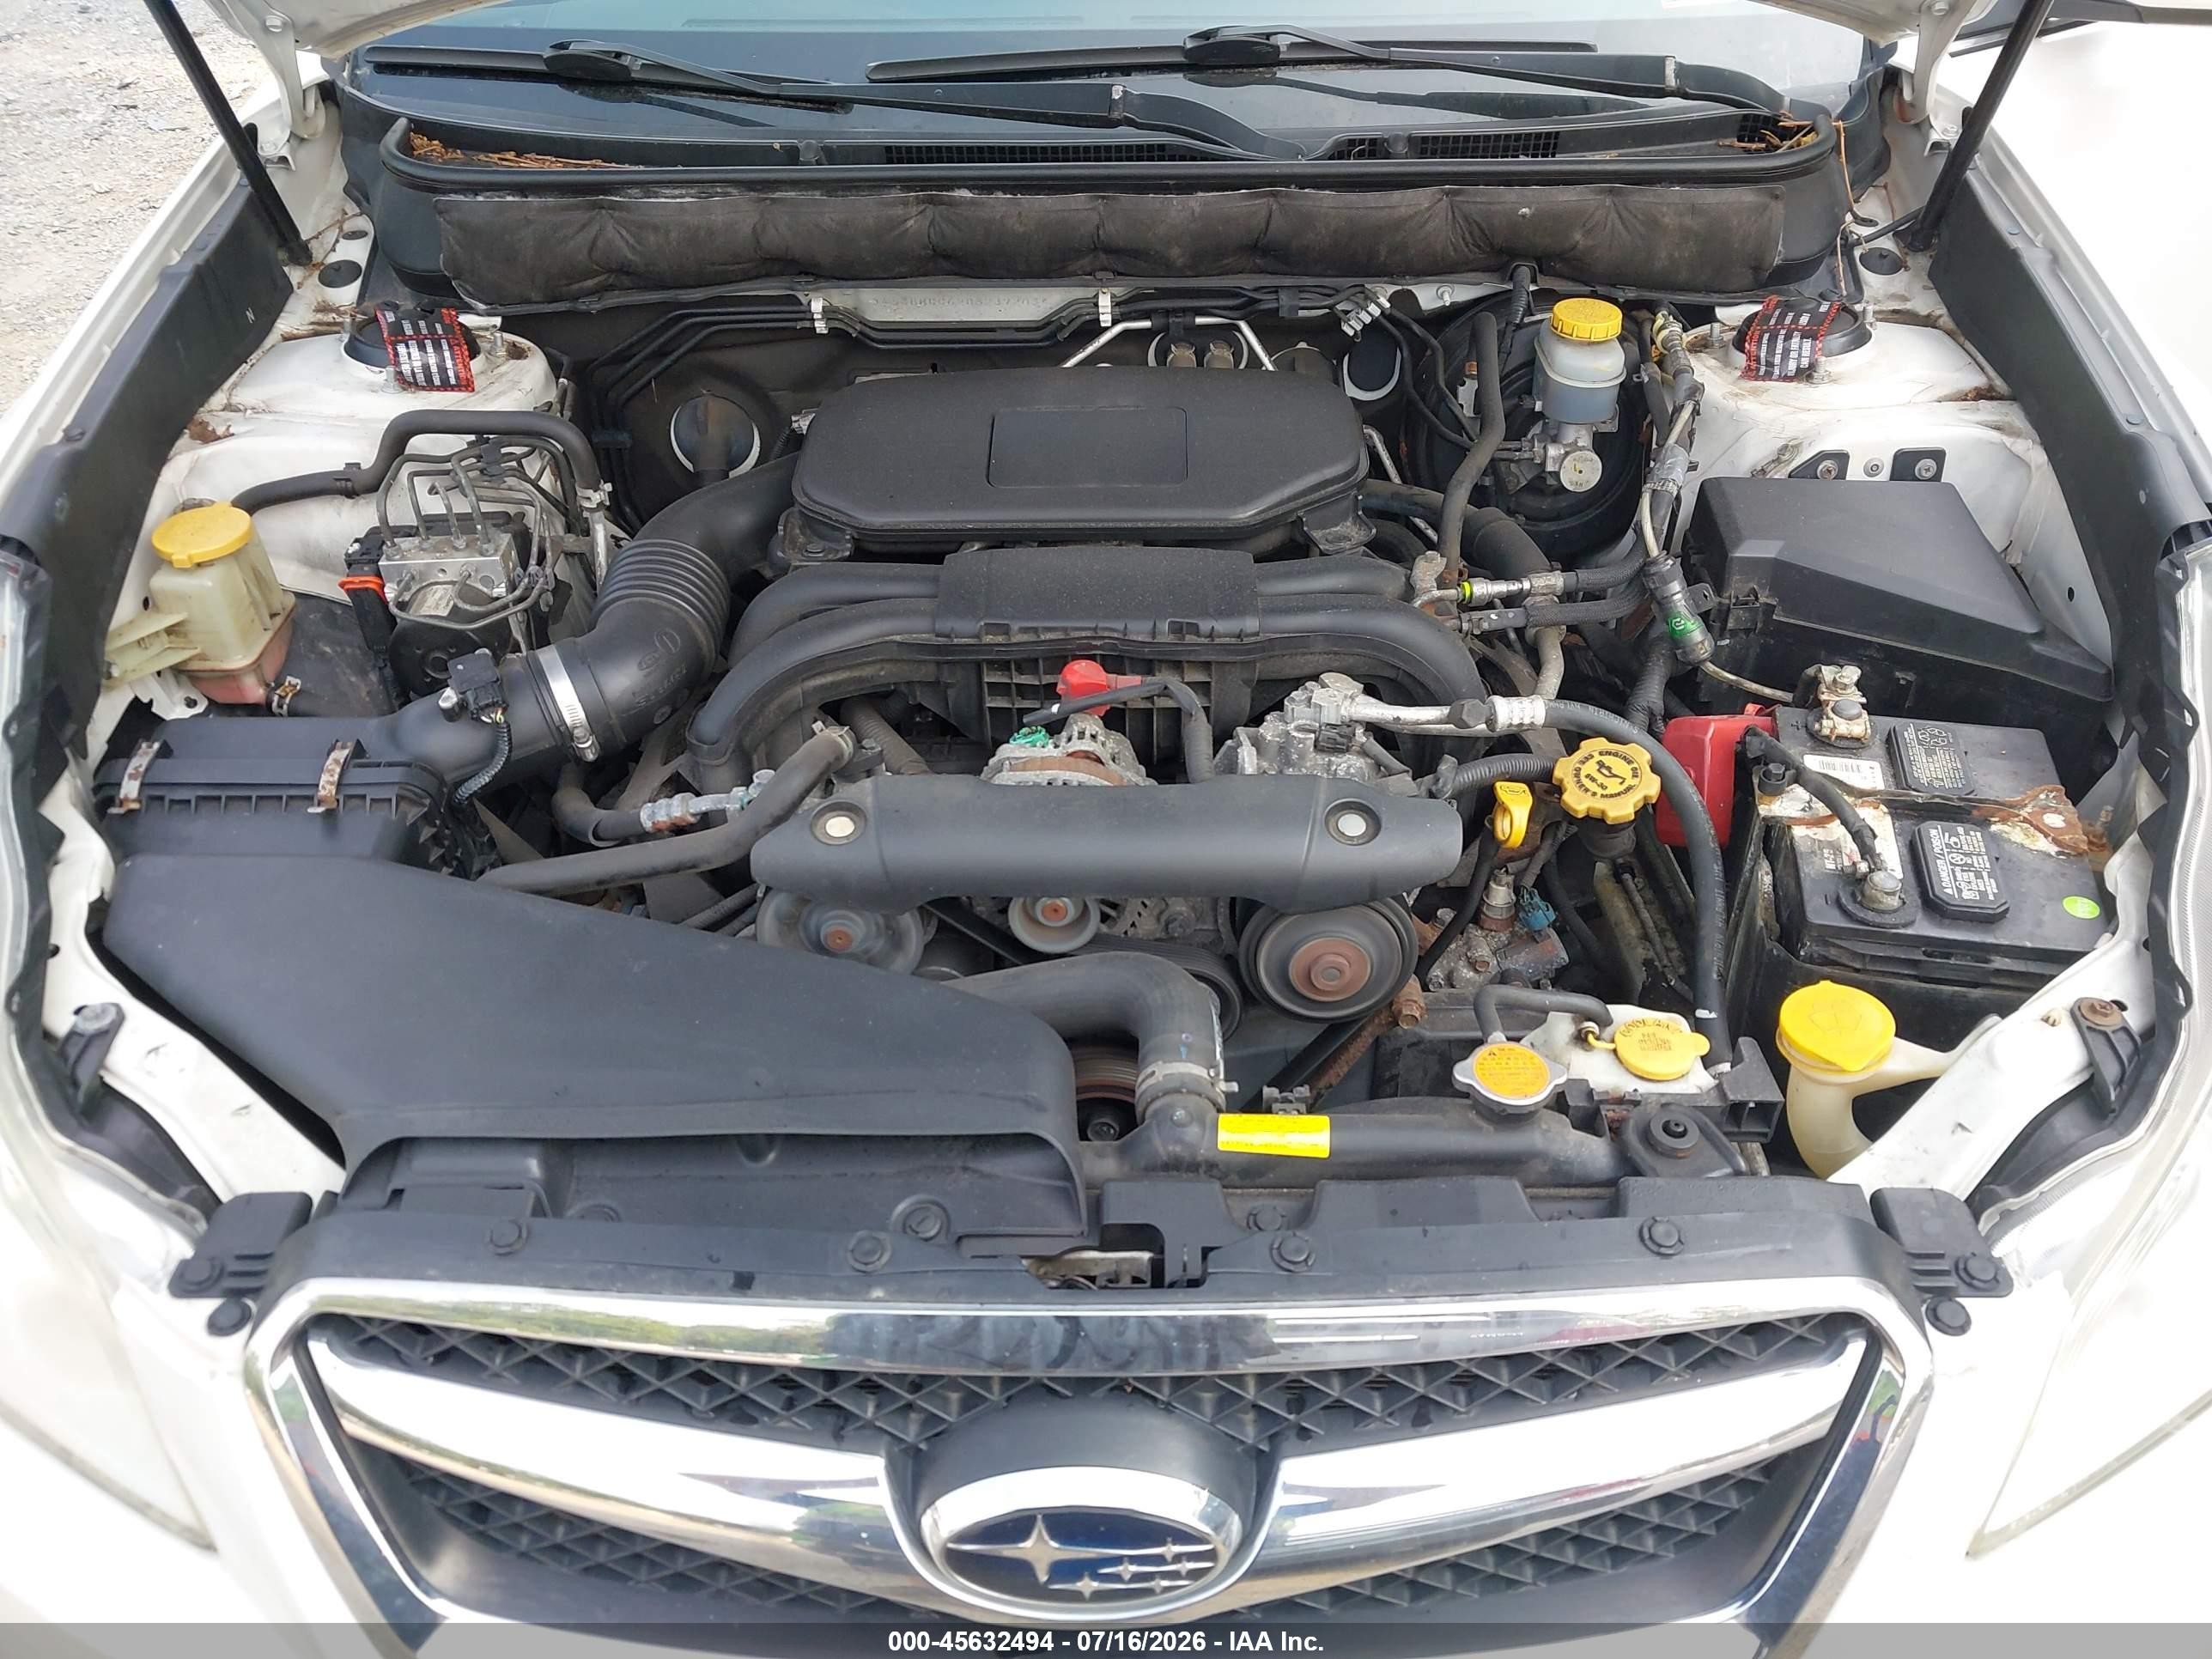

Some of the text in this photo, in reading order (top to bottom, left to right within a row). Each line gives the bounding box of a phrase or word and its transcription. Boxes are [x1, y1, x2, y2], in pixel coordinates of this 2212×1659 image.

[1751, 330, 1760, 369] ATTENTION
[1800, 357, 1809, 368] CAN
[1578, 753, 1595, 766] SEE
[1600, 783, 1636, 799] MANUAL
[1598, 750, 1639, 780] ENGINE OIL
[1584, 773, 1608, 791] 5W-30
[1929, 829, 1943, 854] POISON
[1936, 860, 1952, 887] DANGER
